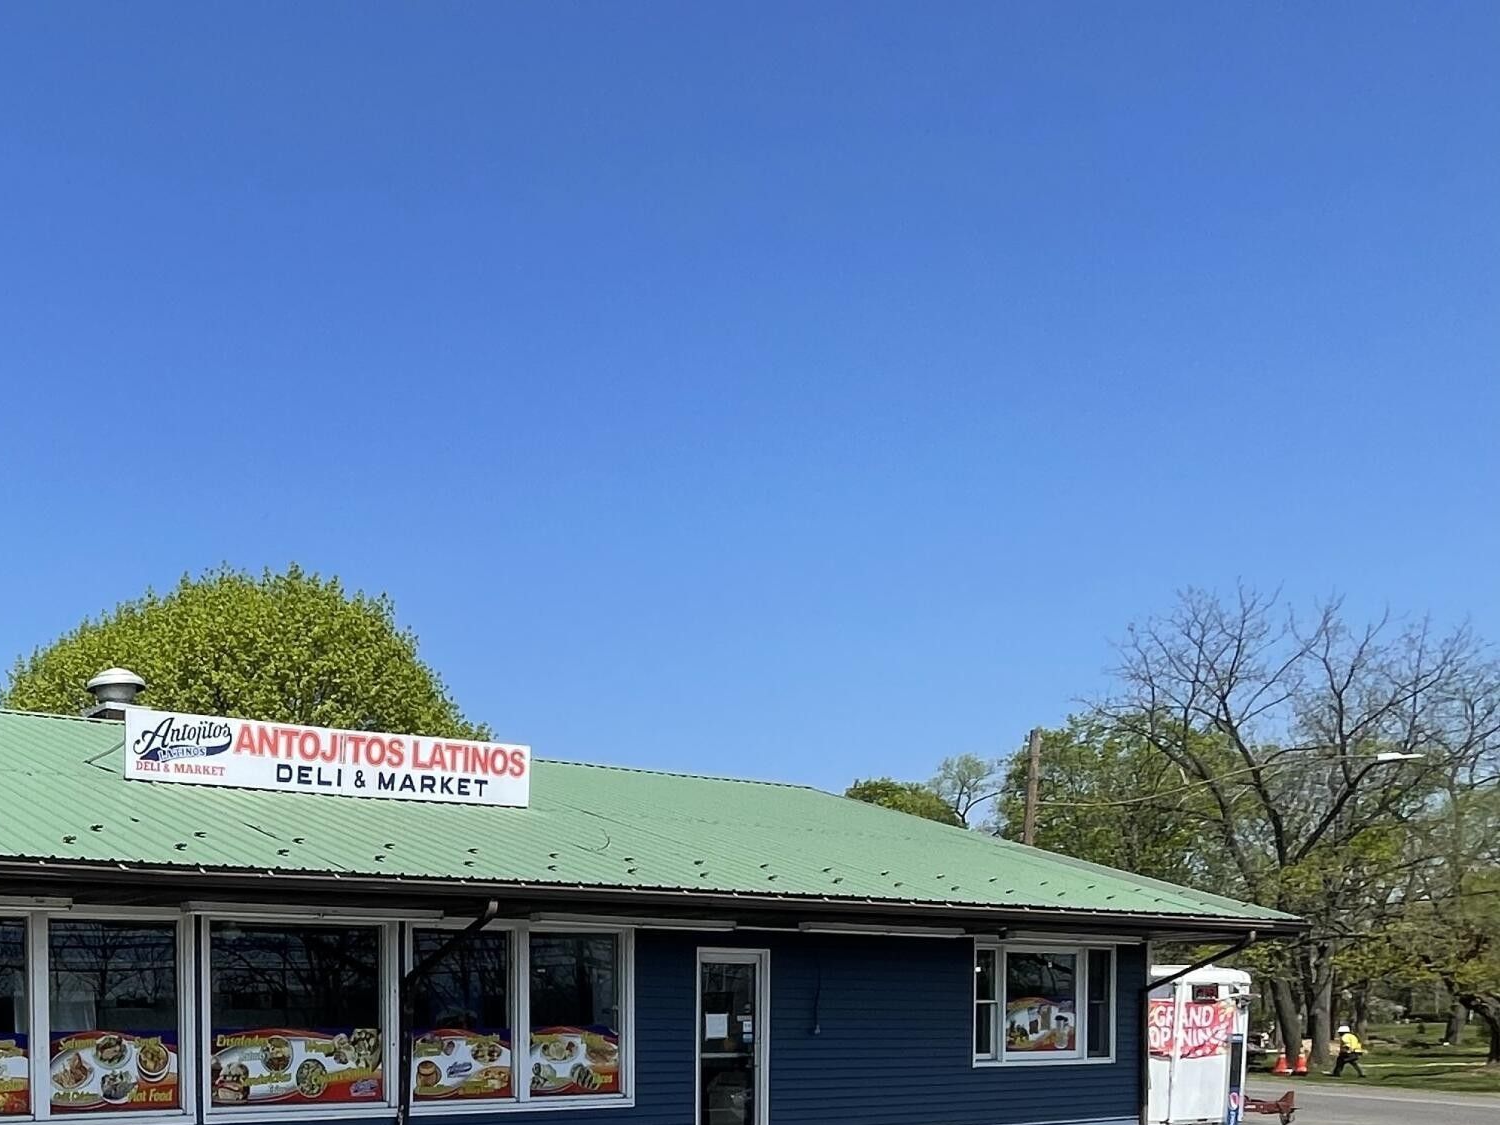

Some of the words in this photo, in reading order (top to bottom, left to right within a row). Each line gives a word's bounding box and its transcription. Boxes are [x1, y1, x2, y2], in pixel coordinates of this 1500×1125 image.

[133, 717, 232, 755] Antojitos
[158, 747, 206, 760] LATINOS
[233, 723, 405, 767] ANTOJITOS
[411, 740, 527, 779] LATINOS
[136, 761, 161, 772] DELI
[163, 763, 171, 773] &
[174, 763, 226, 777] MARKET
[276, 763, 342, 788] DELI
[354, 770, 366, 788] &
[378, 771, 489, 797] MARKET
[148, 1088, 173, 1102] Food
